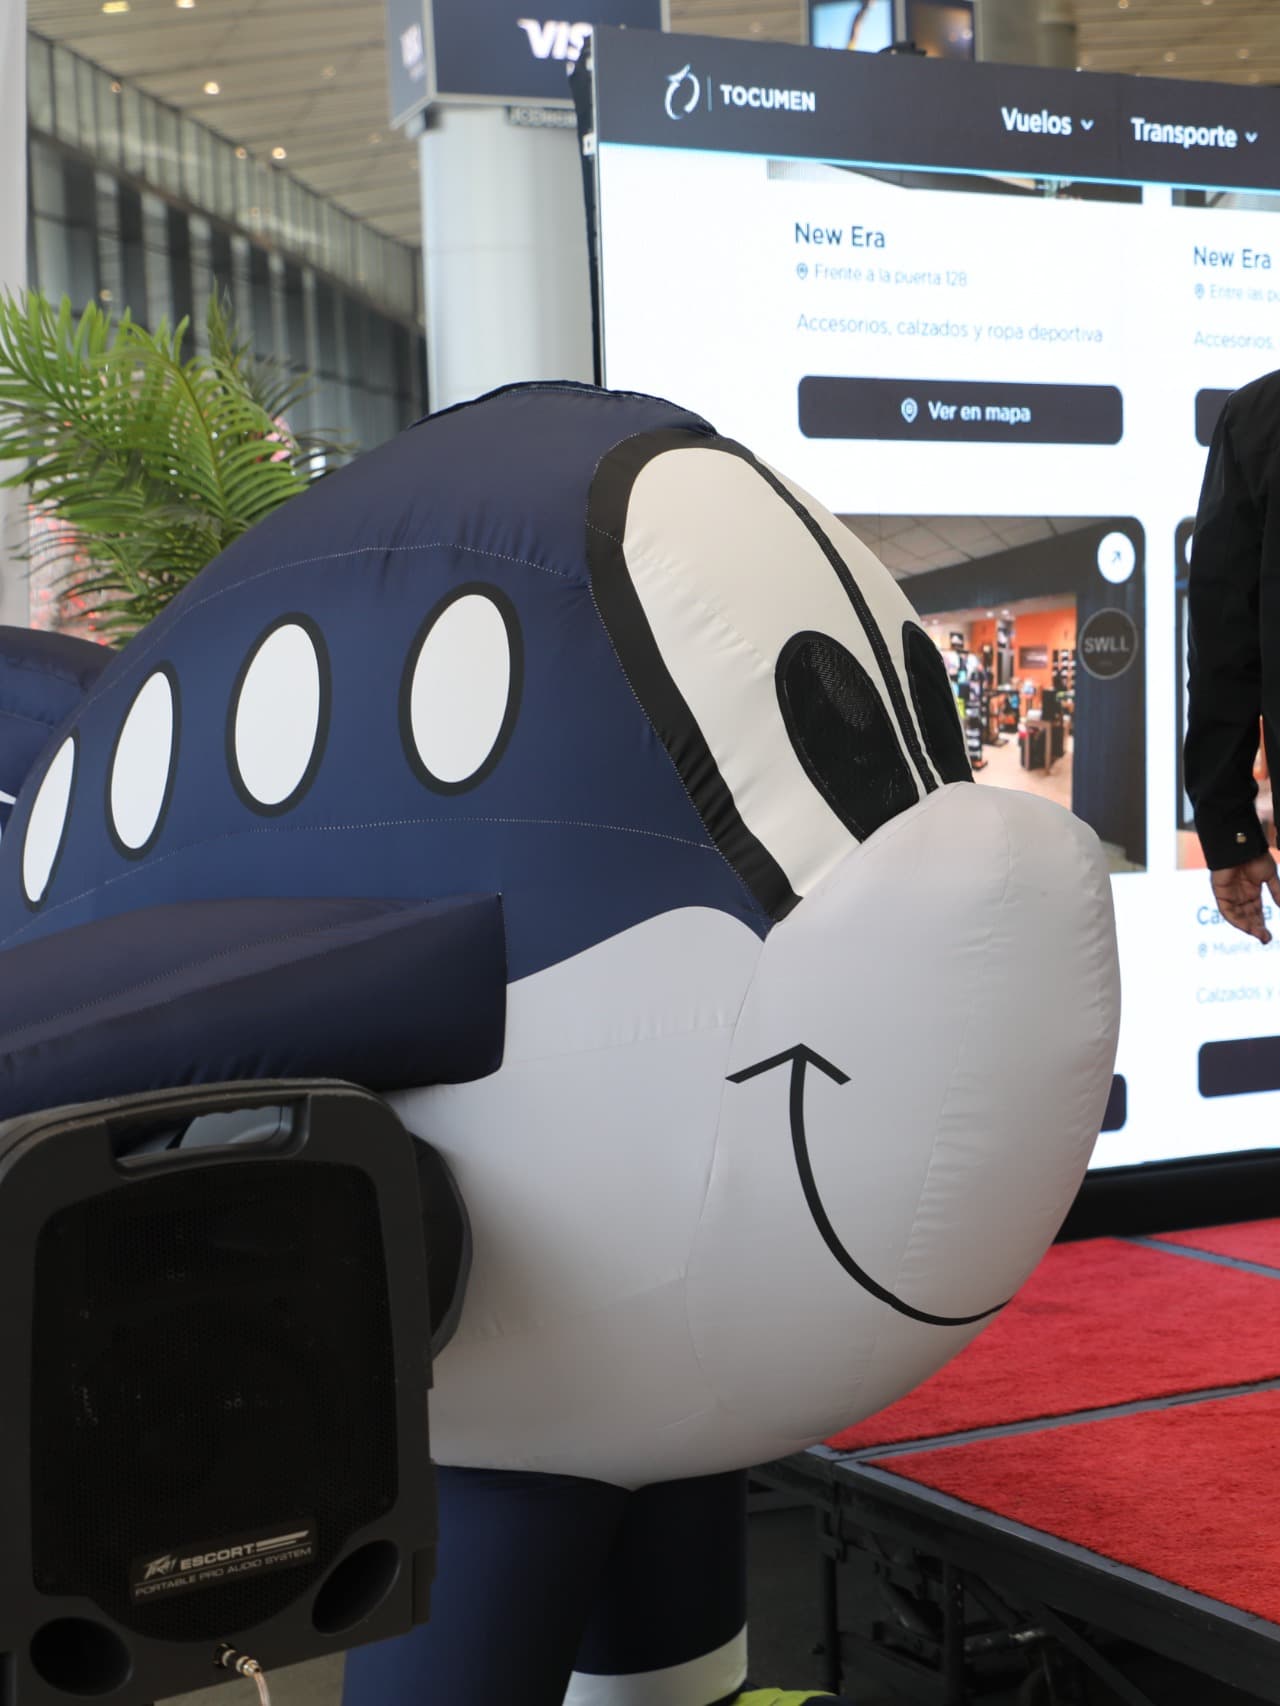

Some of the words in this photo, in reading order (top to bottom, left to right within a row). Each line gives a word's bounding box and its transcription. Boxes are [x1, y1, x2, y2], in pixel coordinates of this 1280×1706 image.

[516, 18, 593, 61] VIS
[719, 84, 816, 112] TOCUMEN
[1001, 107, 1072, 136] Vuelos
[1130, 117, 1238, 149] Transporte
[795, 222, 843, 246] New
[851, 226, 886, 248] Era
[1194, 246, 1235, 268] New
[1242, 248, 1272, 269] Era
[815, 263, 862, 281] Frente
[866, 269, 875, 282] a
[878, 267, 891, 283] la
[895, 270, 941, 286] puerta
[946, 270, 968, 287] 128
[796, 313, 892, 336] Accesorios,
[897, 318, 968, 338] calzados
[974, 324, 984, 341] y
[987, 324, 1024, 342] ropa
[1028, 323, 1104, 344] deportiva
[928, 400, 957, 420] Ver
[960, 405, 982, 421] en
[985, 405, 1031, 425] mapa
[1196, 986, 1260, 1004] Calzados
[180, 1543, 256, 1570] ESCORT
[135, 1574, 197, 1597] PORTABLE
[199, 1567, 225, 1581] PRO
[227, 1558, 263, 1574] AUDIO
[265, 1546, 312, 1566] SYSTEM
